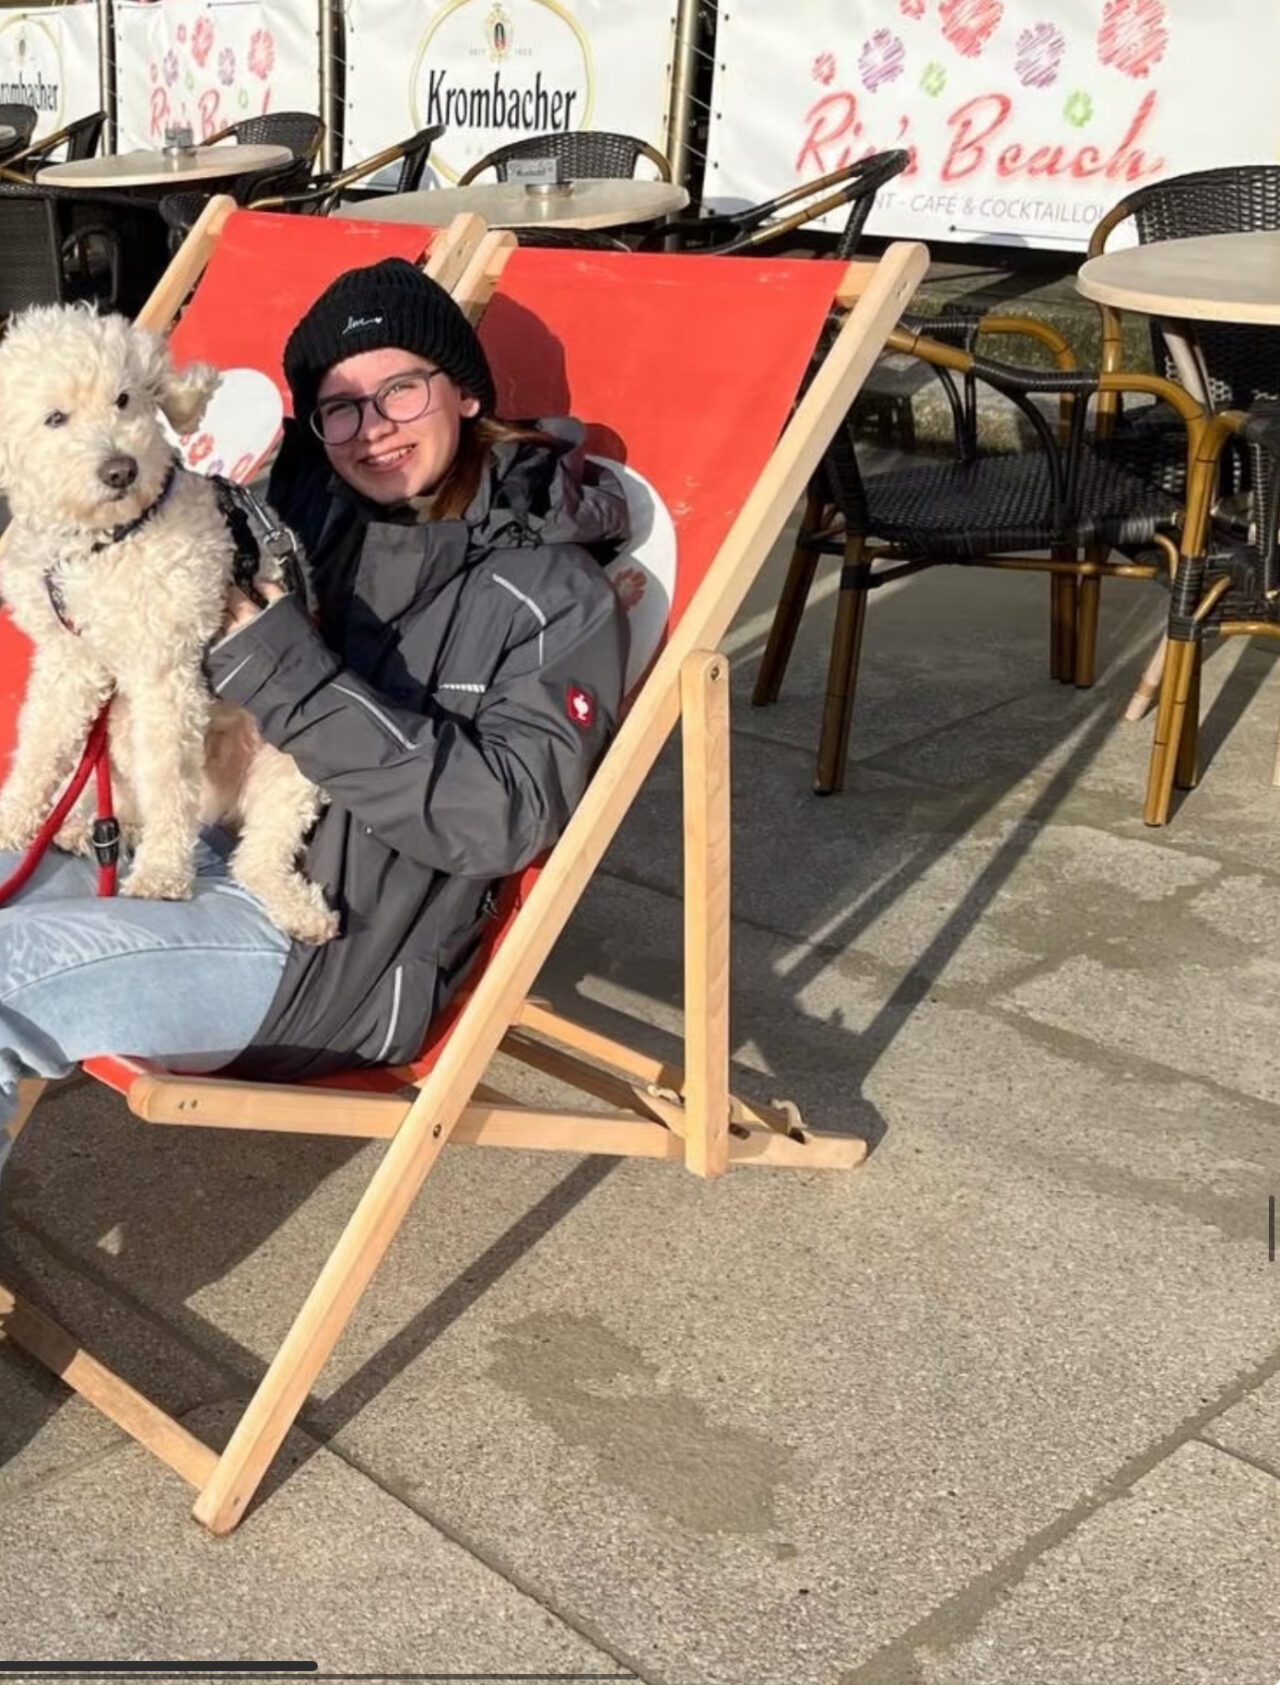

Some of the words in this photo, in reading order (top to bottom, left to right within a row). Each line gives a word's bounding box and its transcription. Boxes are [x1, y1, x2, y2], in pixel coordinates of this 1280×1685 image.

[426, 70, 577, 131] Krombacher
[796, 91, 918, 175] Ri's
[941, 89, 1165, 182] Beach
[910, 194, 956, 215] CAFÉ
[979, 198, 1105, 224] COCKTAILLO
